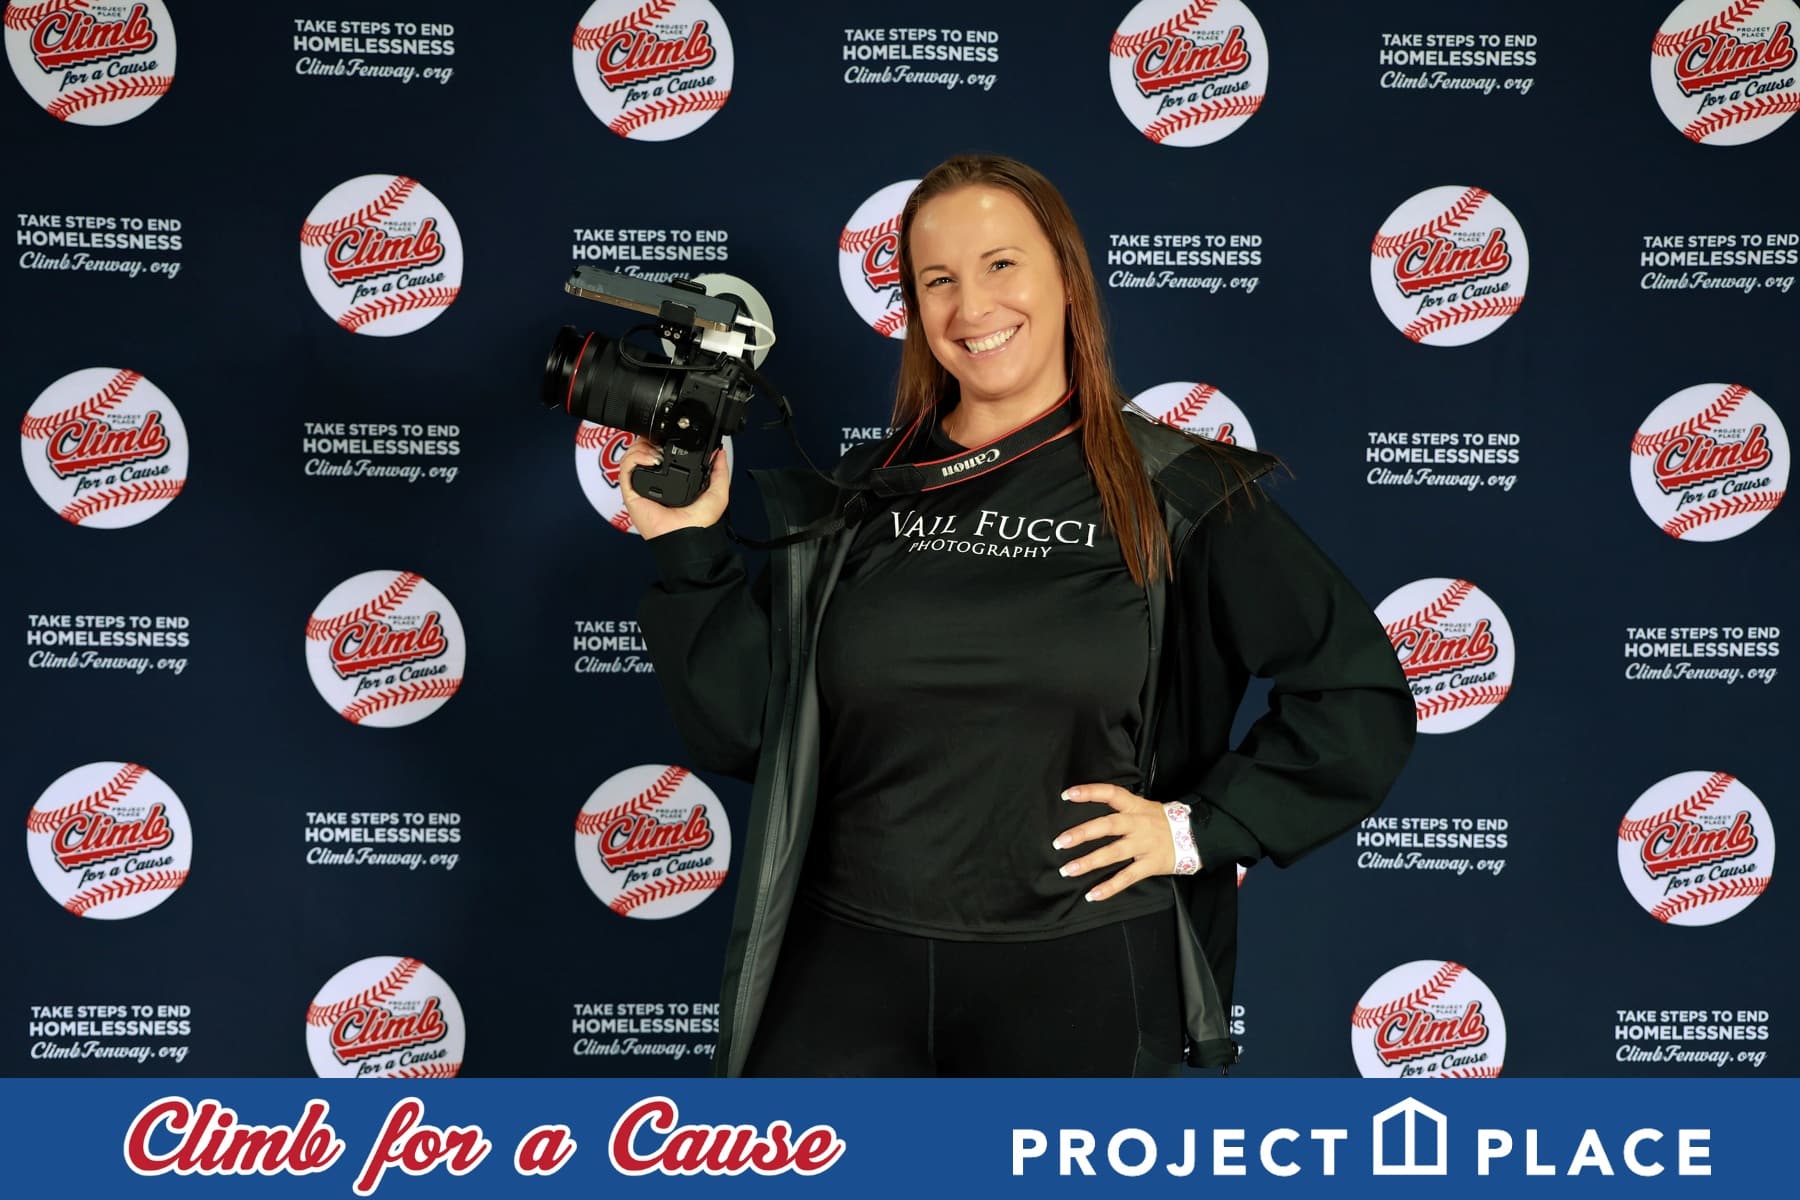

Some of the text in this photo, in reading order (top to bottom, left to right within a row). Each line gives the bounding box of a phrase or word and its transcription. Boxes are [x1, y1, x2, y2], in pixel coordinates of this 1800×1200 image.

[32, 4, 155, 55] Climb
[294, 20, 454, 36] TAKE STEPS TO END
[845, 29, 998, 43] TAKE STEPS TO END
[294, 36, 454, 55] HOMELESSNESS
[598, 21, 714, 74] Climb
[1382, 34, 1537, 47] TAKE STEPS TO END
[844, 45, 998, 62] HOMELESSNESS
[1134, 26, 1249, 81] Climb
[1380, 50, 1536, 66] HOMELESSNESS
[1676, 22, 1795, 79] Climb
[59, 60, 159, 92] for a Cause
[622, 75, 717, 109] for a Cause
[1156, 80, 1251, 115] for a Cause
[1697, 77, 1796, 114] for a Cause
[18, 214, 181, 231] TAKE STEPS TO END
[17, 230, 182, 250] HOMELESSNESS
[326, 218, 443, 270] Climb
[574, 229, 728, 242] TAKE STEPS TO END
[1110, 235, 1262, 247] TAKE STEPS TO END
[1644, 234, 1799, 248] TAKE STEPS TO END
[573, 245, 728, 260] HOMELESSNESS
[1108, 250, 1261, 265] HOMELESSNESS
[1395, 228, 1510, 281] Climb
[1641, 250, 1798, 266] HOMELESSNESS
[1416, 282, 1511, 315] for a Cause
[48, 411, 168, 462] Climb
[1368, 432, 1520, 445] TAKE STEPS TO END
[304, 438, 460, 455] HOMELESSNESS
[1655, 424, 1770, 478] Climb
[942, 448, 1000, 477] Canon
[1367, 448, 1519, 464] HOMELESSNESS
[73, 465, 171, 497] for a Cause
[1676, 477, 1772, 511] for a Cause
[891, 510, 1097, 548] VAIL FUCCI
[908, 538, 1052, 558] PHOTOGRAPHY
[29, 615, 189, 628] TAKE STEPS TO END
[575, 621, 614, 632] TAKE
[28, 630, 189, 647] HOMELESSNESS
[331, 612, 446, 663] Climb
[1627, 627, 1780, 639] TAKE STEPS TO END
[1625, 642, 1779, 657] HOMELESSNESS
[53, 803, 172, 855] Climb
[600, 805, 712, 856] Climb
[1402, 818, 1448, 830] STEPS
[1452, 819, 1472, 830] TO
[1477, 819, 1508, 830] END
[306, 828, 460, 842] HOMELESSNESS
[1357, 832, 1508, 848] HOMELESSNESS
[1642, 811, 1756, 863] Climb
[622, 856, 714, 889] for a Cause
[1664, 863, 1757, 896] for a Cause
[31, 1006, 190, 1018] TAKE STEPS TO END
[574, 1004, 613, 1015] TAKE
[618, 1004, 664, 1015] STEPS
[668, 1004, 688, 1015] TO
[1617, 1010, 1768, 1022] TAKE STEPS TO END
[30, 1020, 190, 1036] HOMELESSNESS
[331, 997, 446, 1049] Climb
[1376, 1001, 1487, 1051] Climb
[1616, 1026, 1768, 1040] HOMELESSNESS
